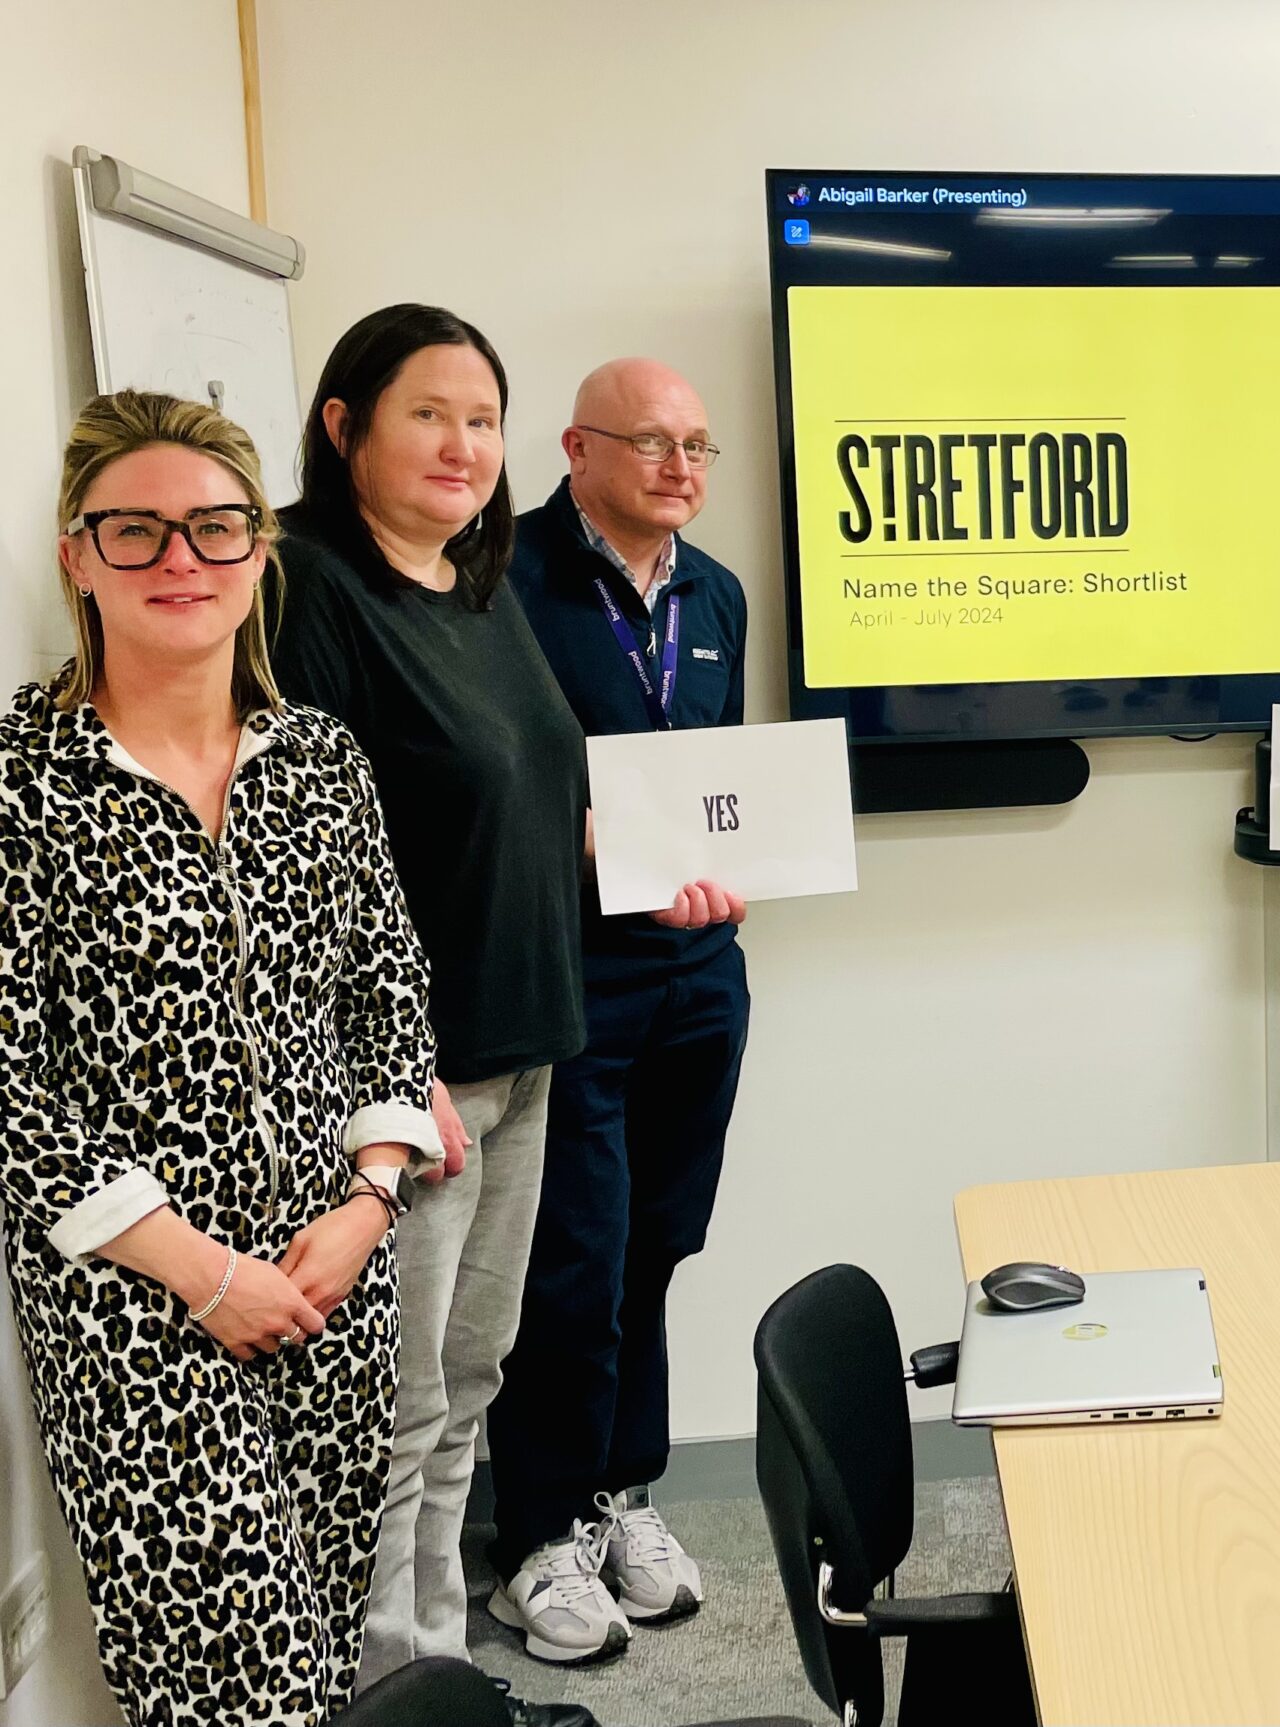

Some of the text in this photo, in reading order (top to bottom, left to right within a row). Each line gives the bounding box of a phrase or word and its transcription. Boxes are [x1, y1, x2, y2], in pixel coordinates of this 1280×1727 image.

[818, 187, 1027, 207] Abigail Barker (Presenting)
[836, 431, 1129, 544] STRETFORD
[593, 577, 621, 622] bruntwood
[843, 570, 1188, 601] Name the Square: Shortlist
[667, 603, 678, 644] bruntwood
[850, 610, 893, 630] April
[914, 609, 952, 629] July
[958, 607, 1004, 625] 2024
[627, 650, 654, 696] bruntwood
[702, 793, 740, 833] YES
